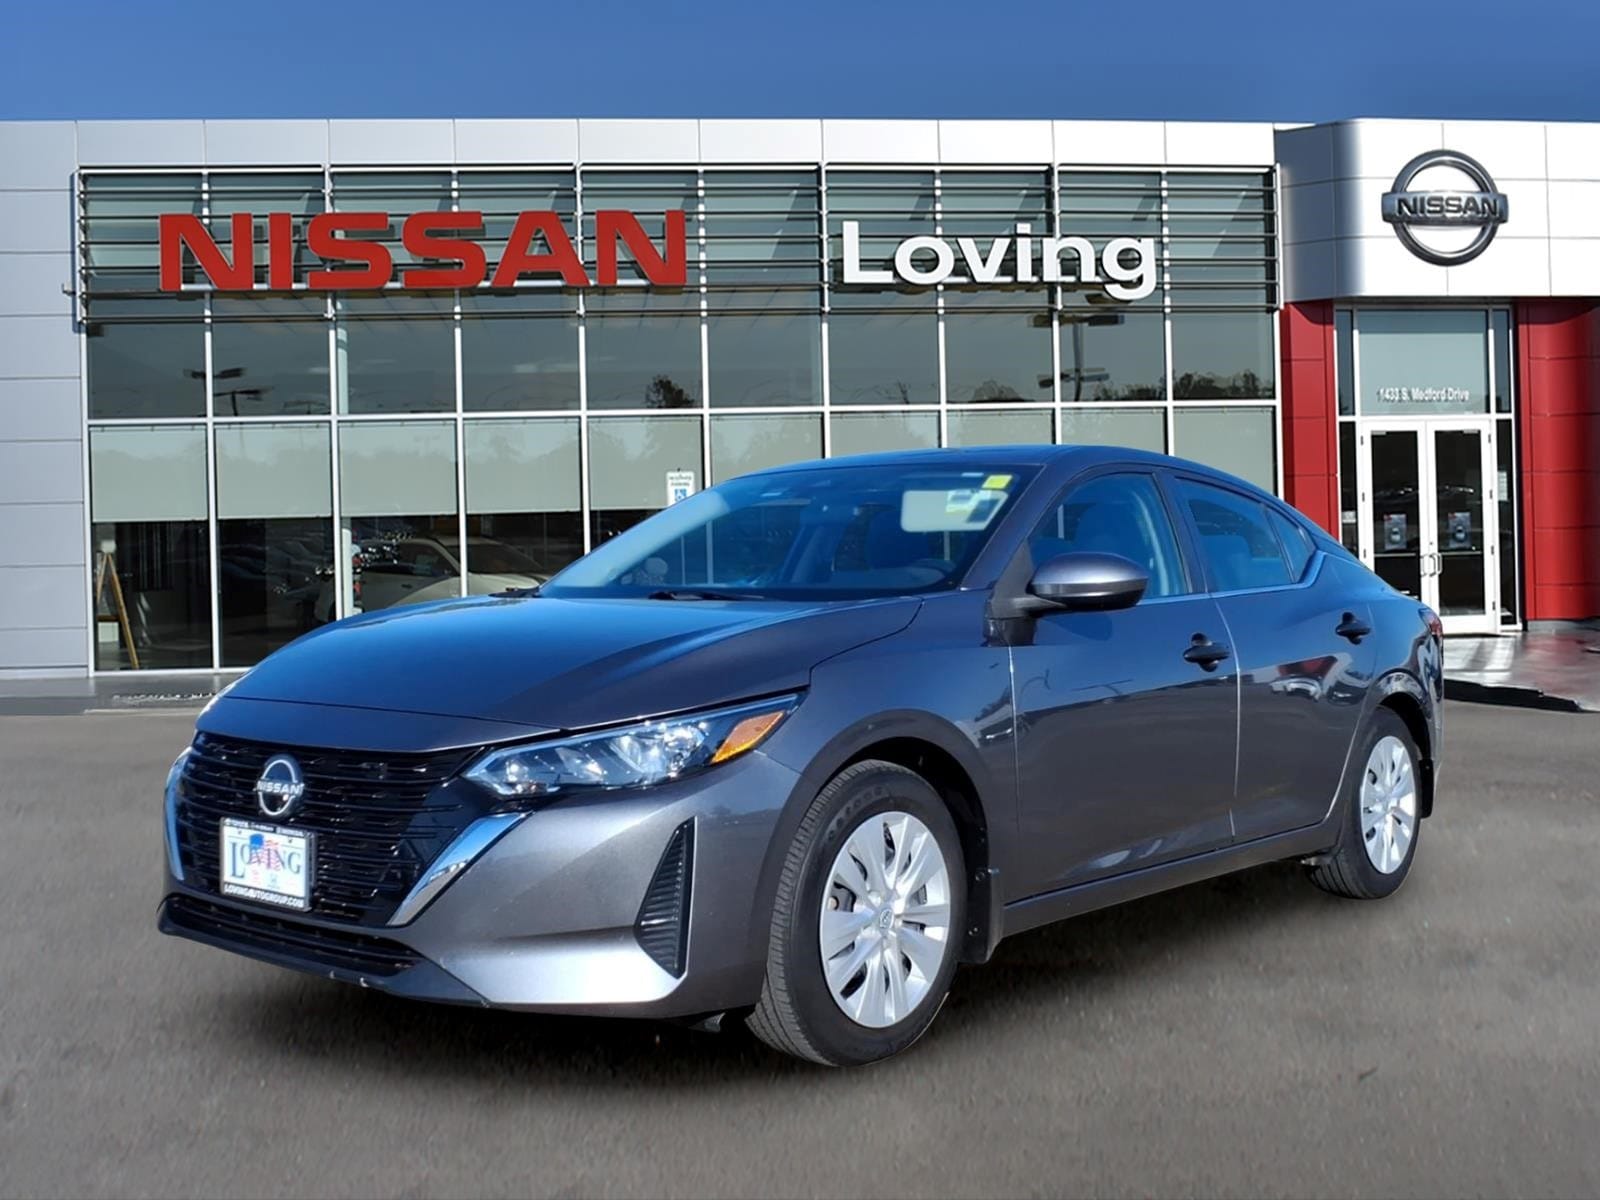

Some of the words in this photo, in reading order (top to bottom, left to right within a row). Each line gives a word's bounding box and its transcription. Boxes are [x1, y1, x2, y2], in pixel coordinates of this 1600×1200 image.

[1396, 195, 1499, 217] NISSAN
[159, 210, 687, 292] NISSAN
[842, 220, 1157, 301] Loving
[1447, 388, 1470, 401] Drive
[257, 781, 301, 794] NISSAN
